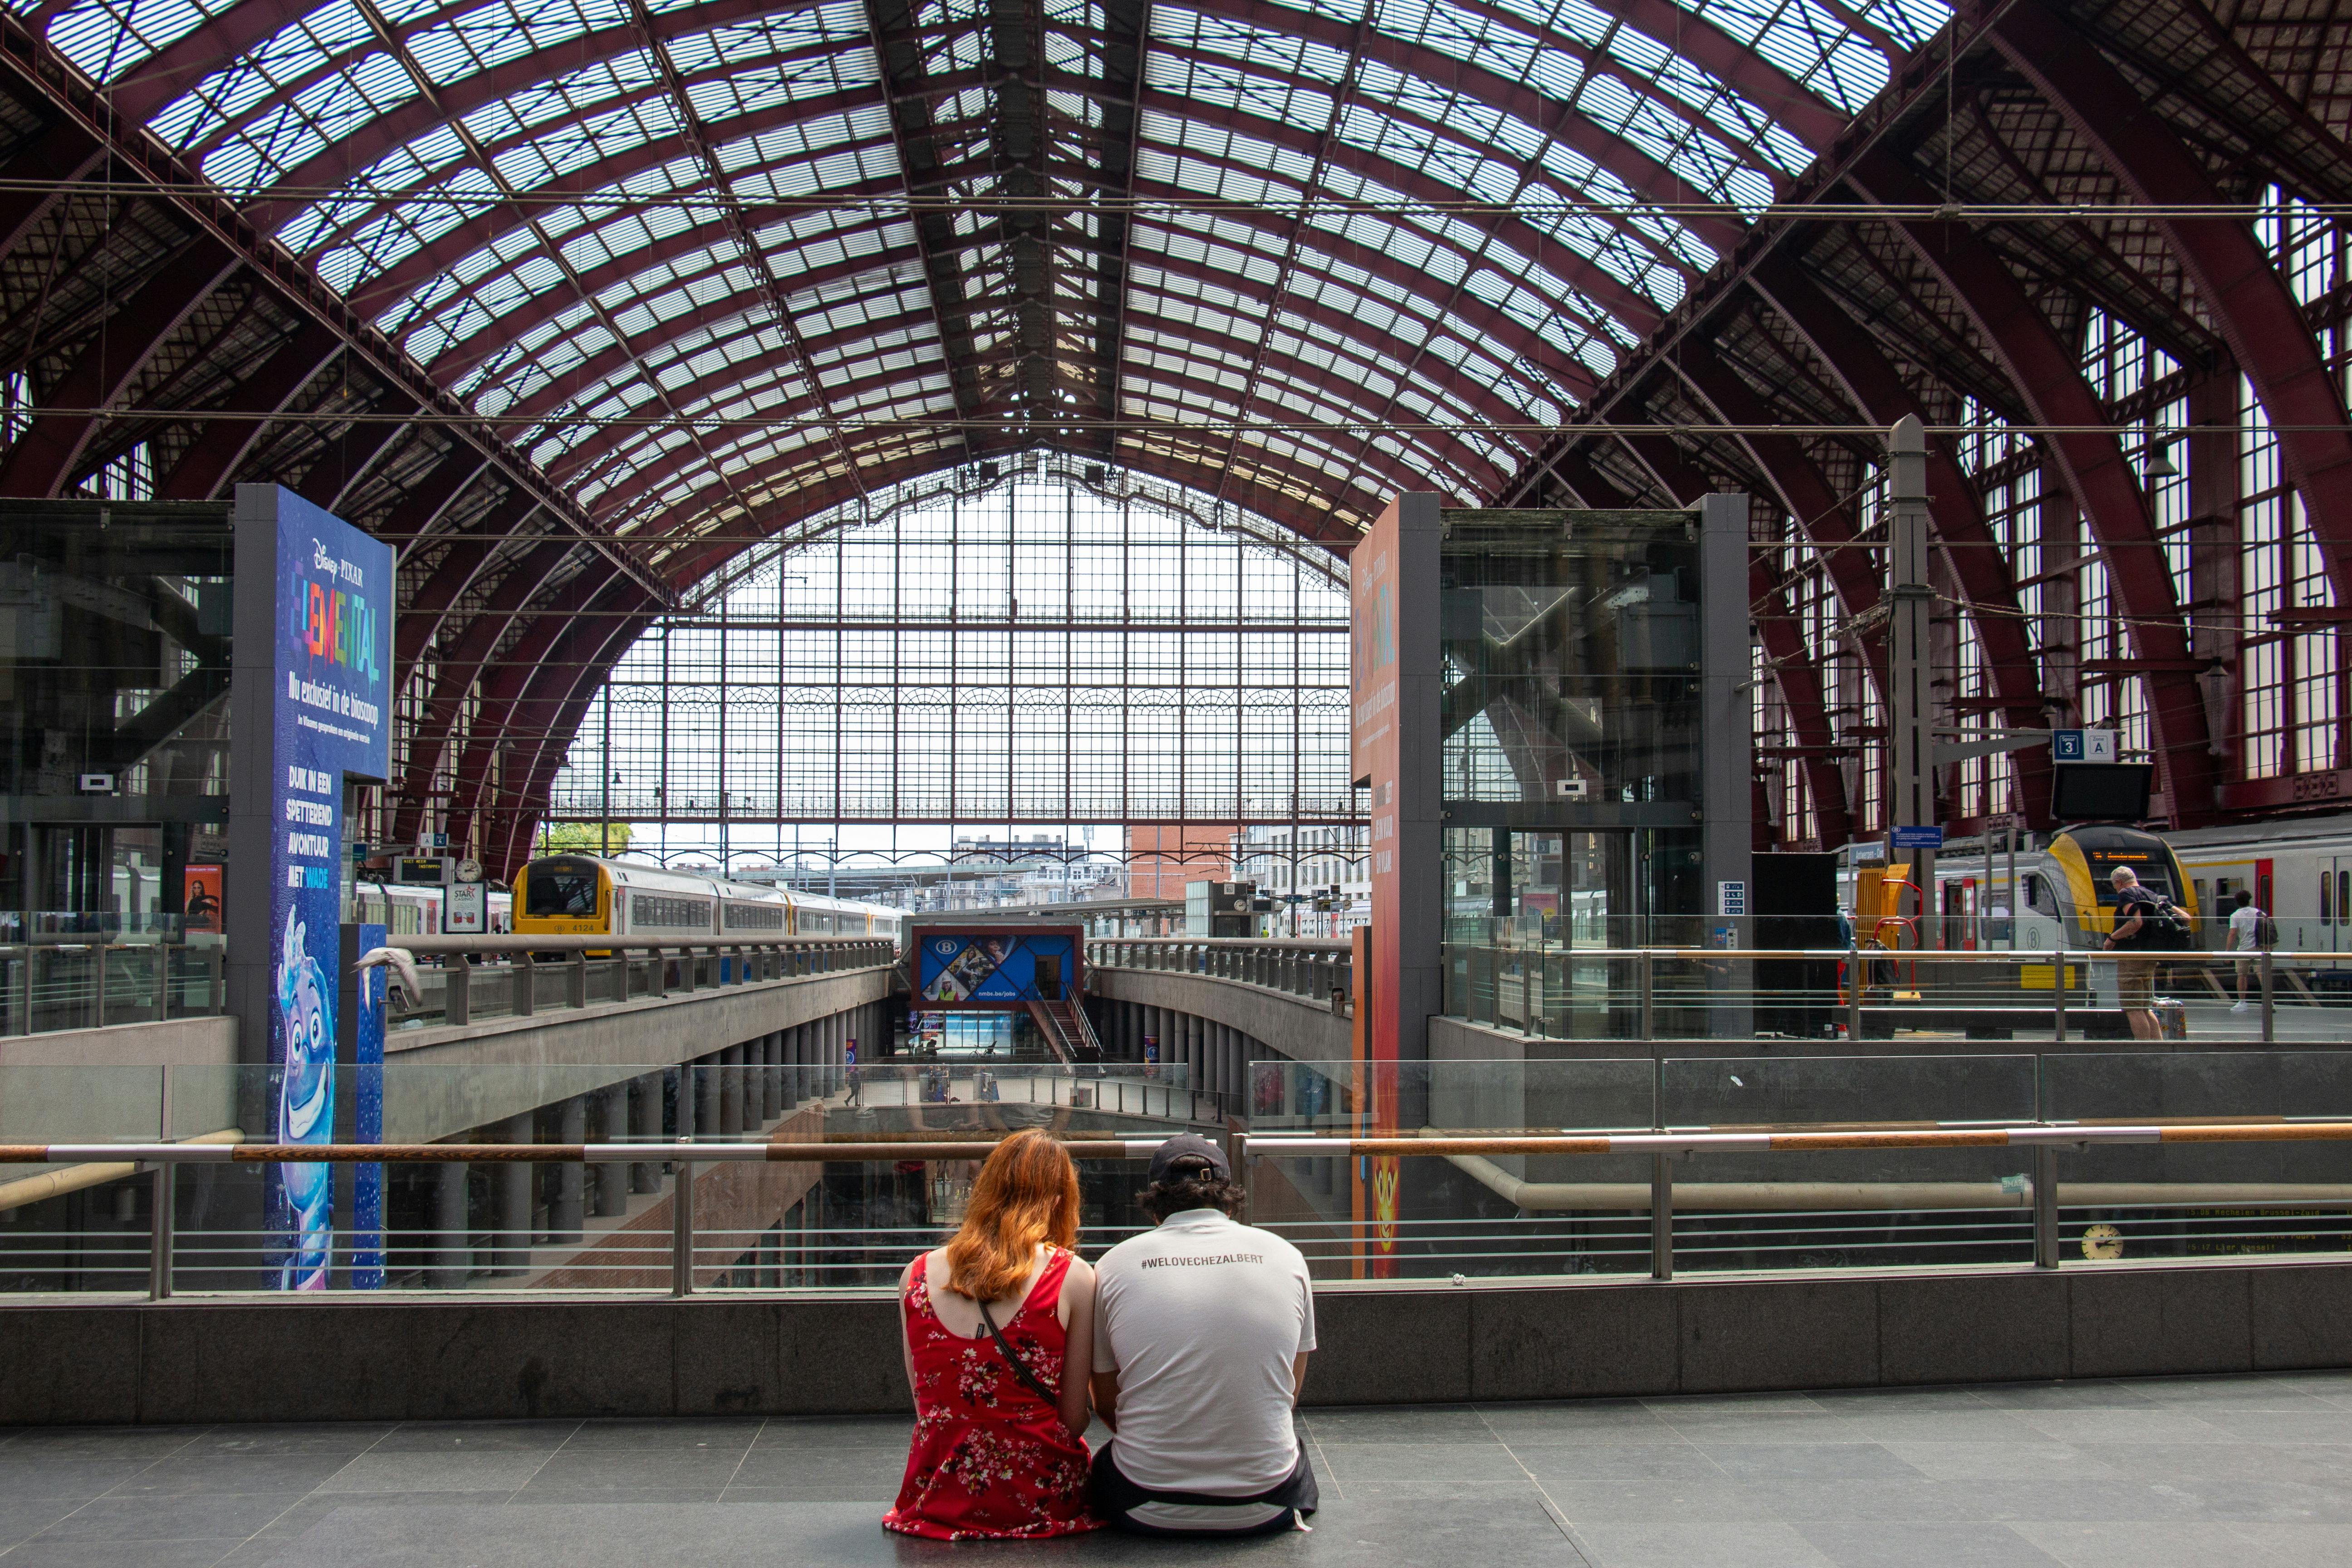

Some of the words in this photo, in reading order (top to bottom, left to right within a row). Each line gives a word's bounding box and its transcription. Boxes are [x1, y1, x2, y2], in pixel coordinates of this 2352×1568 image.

[312, 538, 337, 584] Disney
[340, 559, 363, 588] PIXAR
[1374, 551, 1387, 581] PIXAR
[289, 560, 380, 682] ELEMENTAL
[289, 671, 300, 701] Nu
[301, 678, 332, 710] exclusief
[332, 685, 340, 714] in
[341, 689, 350, 716] de
[351, 691, 378, 730] bioscoop
[298, 714, 303, 725] In
[303, 715, 318, 729] Vlaams
[318, 721, 338, 735] gesproken
[338, 727, 343, 737] en
[343, 728, 359, 741] originele
[359, 733, 370, 745] versie
[2065, 742, 2073, 753] 3
[2095, 742, 2103, 753] A
[289, 765, 308, 791] DUIK
[308, 769, 317, 792] IN
[317, 771, 332, 795] EEN
[286, 799, 333, 826] SPETTEREND
[288, 832, 329, 858] AVONTUUR
[1856, 851, 1874, 859] Antwerpen
[288, 865, 304, 888] MET
[305, 866, 328, 890] WADE
[1141, 1253, 1264, 1269] #WELOVECHEZALBERT
